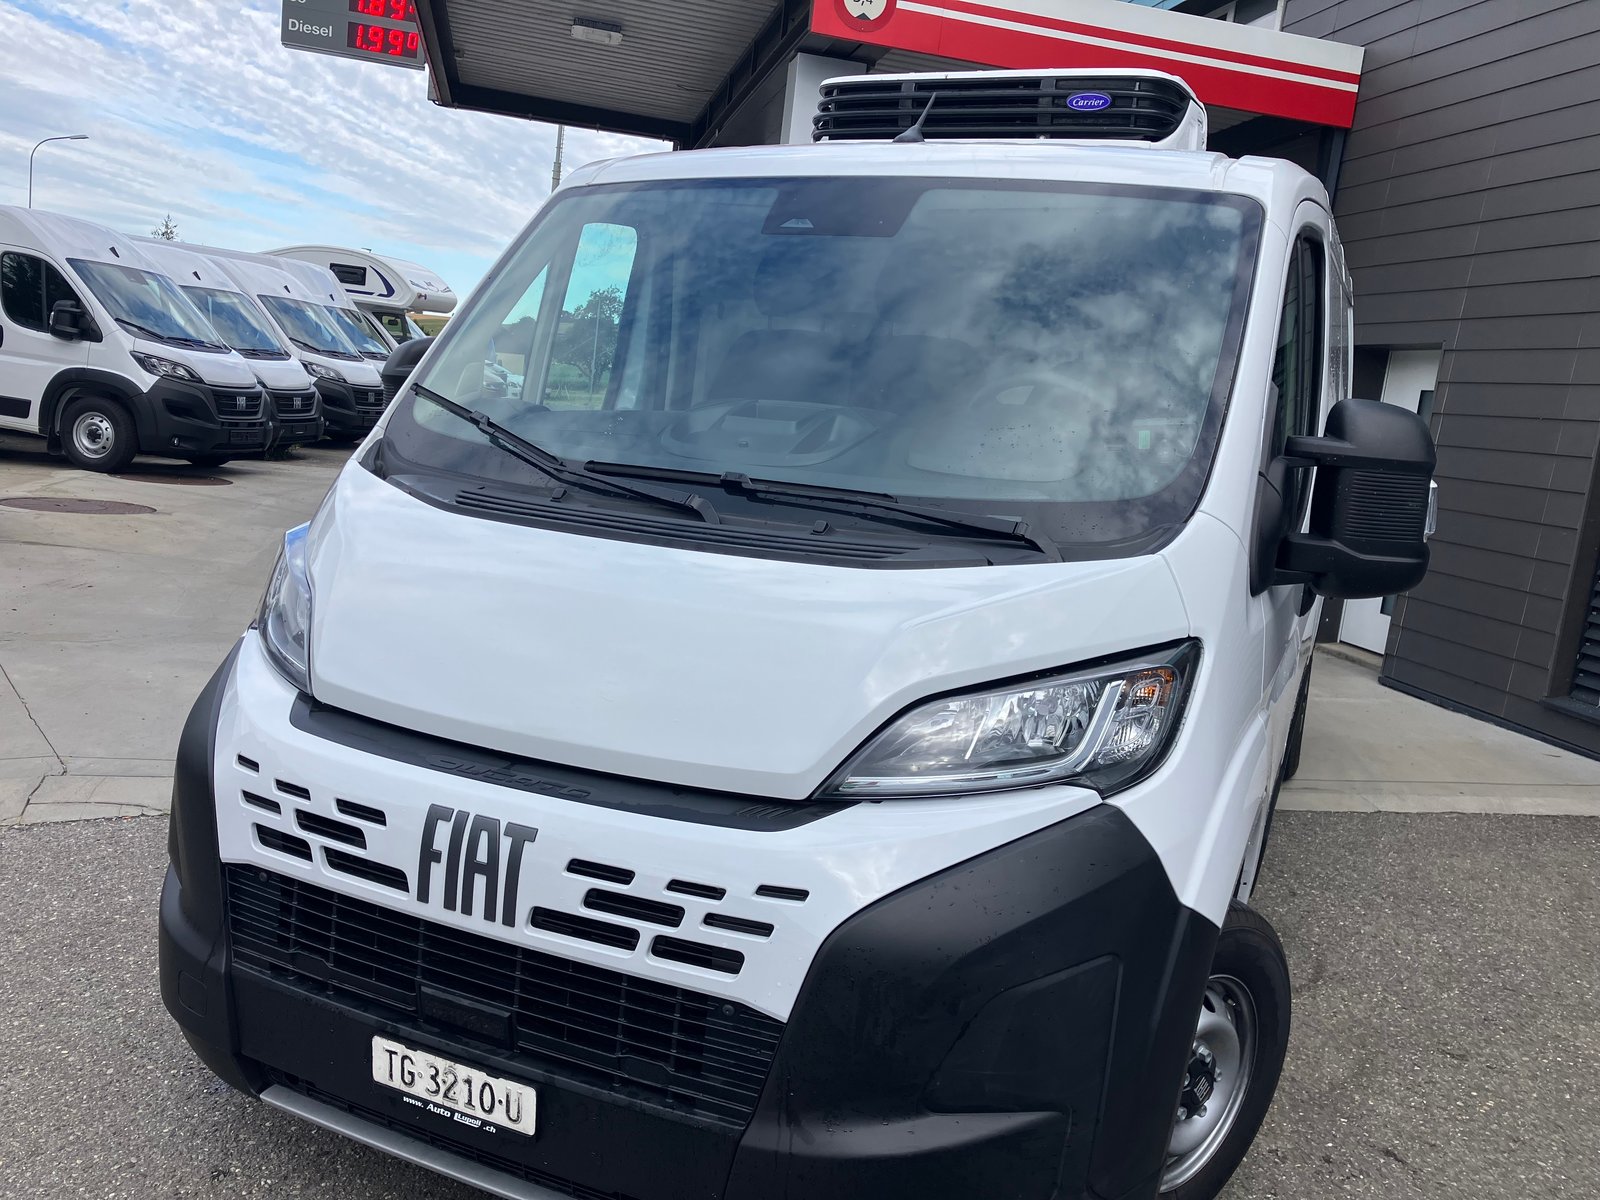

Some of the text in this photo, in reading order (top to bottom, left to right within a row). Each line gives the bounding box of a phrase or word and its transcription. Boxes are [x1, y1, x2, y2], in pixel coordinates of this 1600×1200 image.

[288, 18, 333, 38] Diesel
[1072, 98, 1105, 107] Carrier
[416, 803, 539, 928] FIAT
[426, 1103, 451, 1118] Auto
